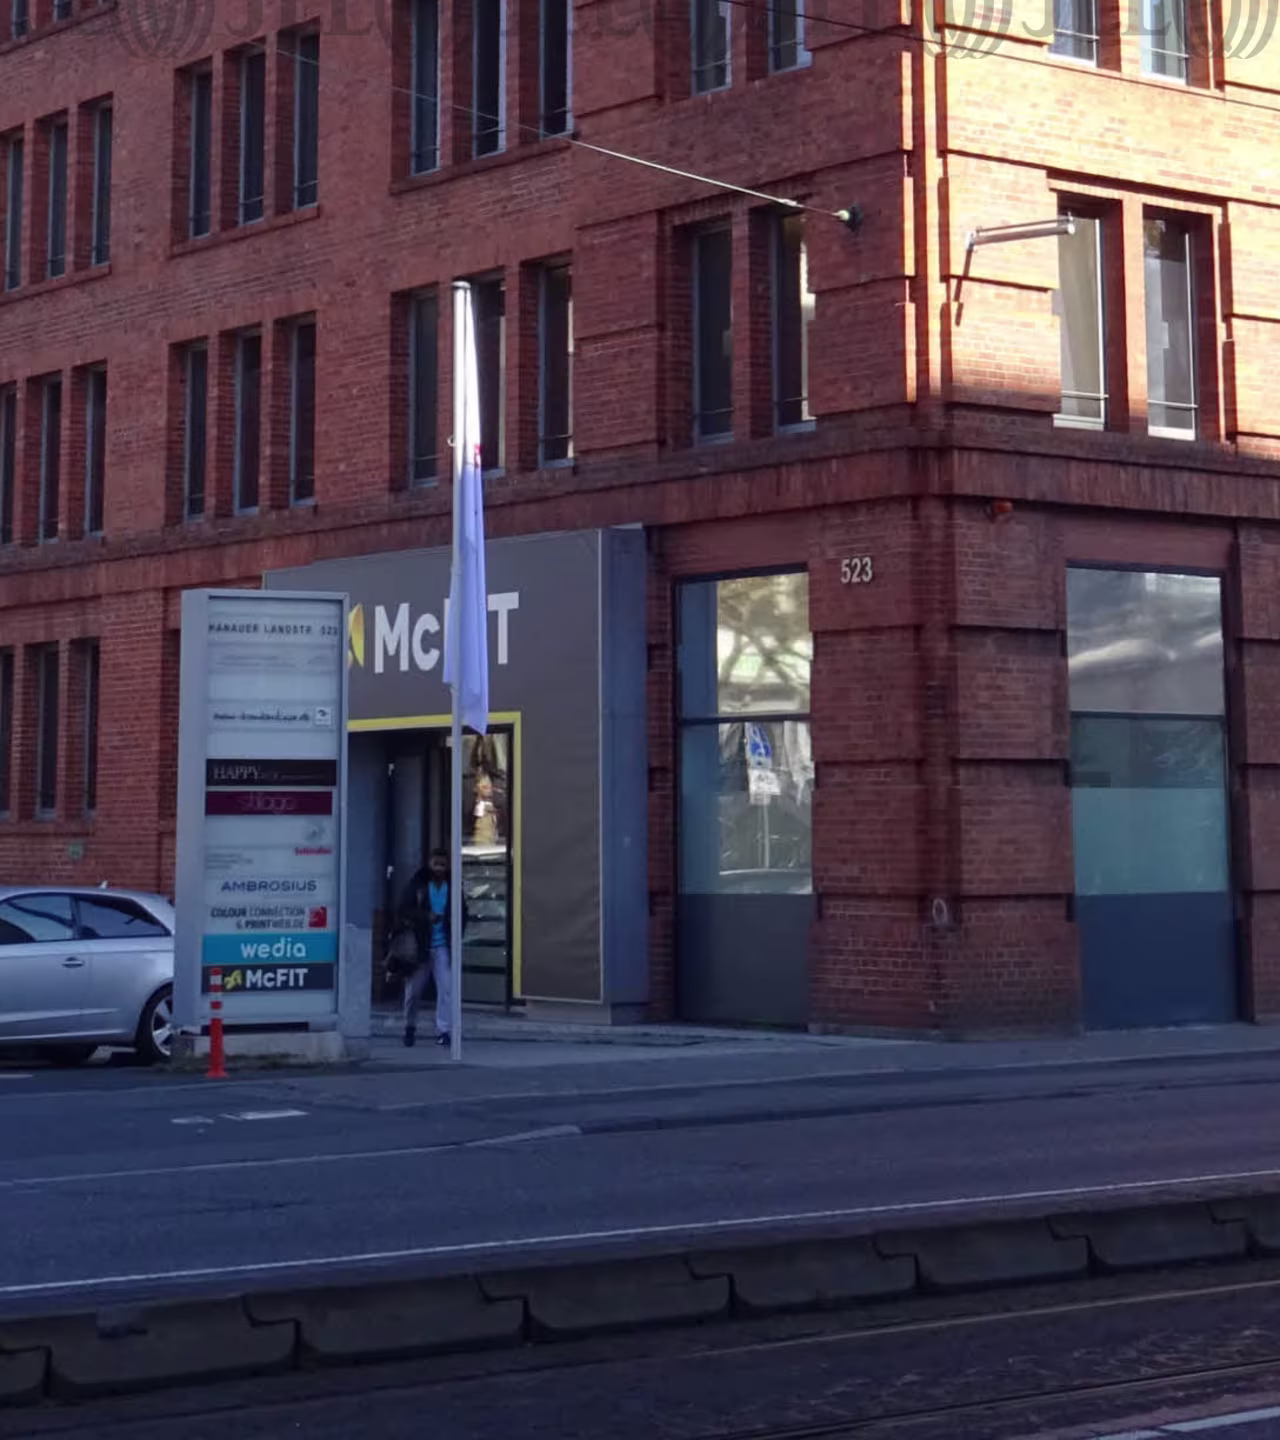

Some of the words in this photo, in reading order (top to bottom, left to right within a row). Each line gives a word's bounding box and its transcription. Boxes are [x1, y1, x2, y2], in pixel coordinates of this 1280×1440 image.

[840, 556, 873, 584] 523
[374, 591, 519, 674] McT
[213, 765, 260, 780] HAPPY
[220, 880, 317, 892] AMBROSIUS
[240, 937, 307, 958] wedia
[245, 968, 309, 988] McFIT
